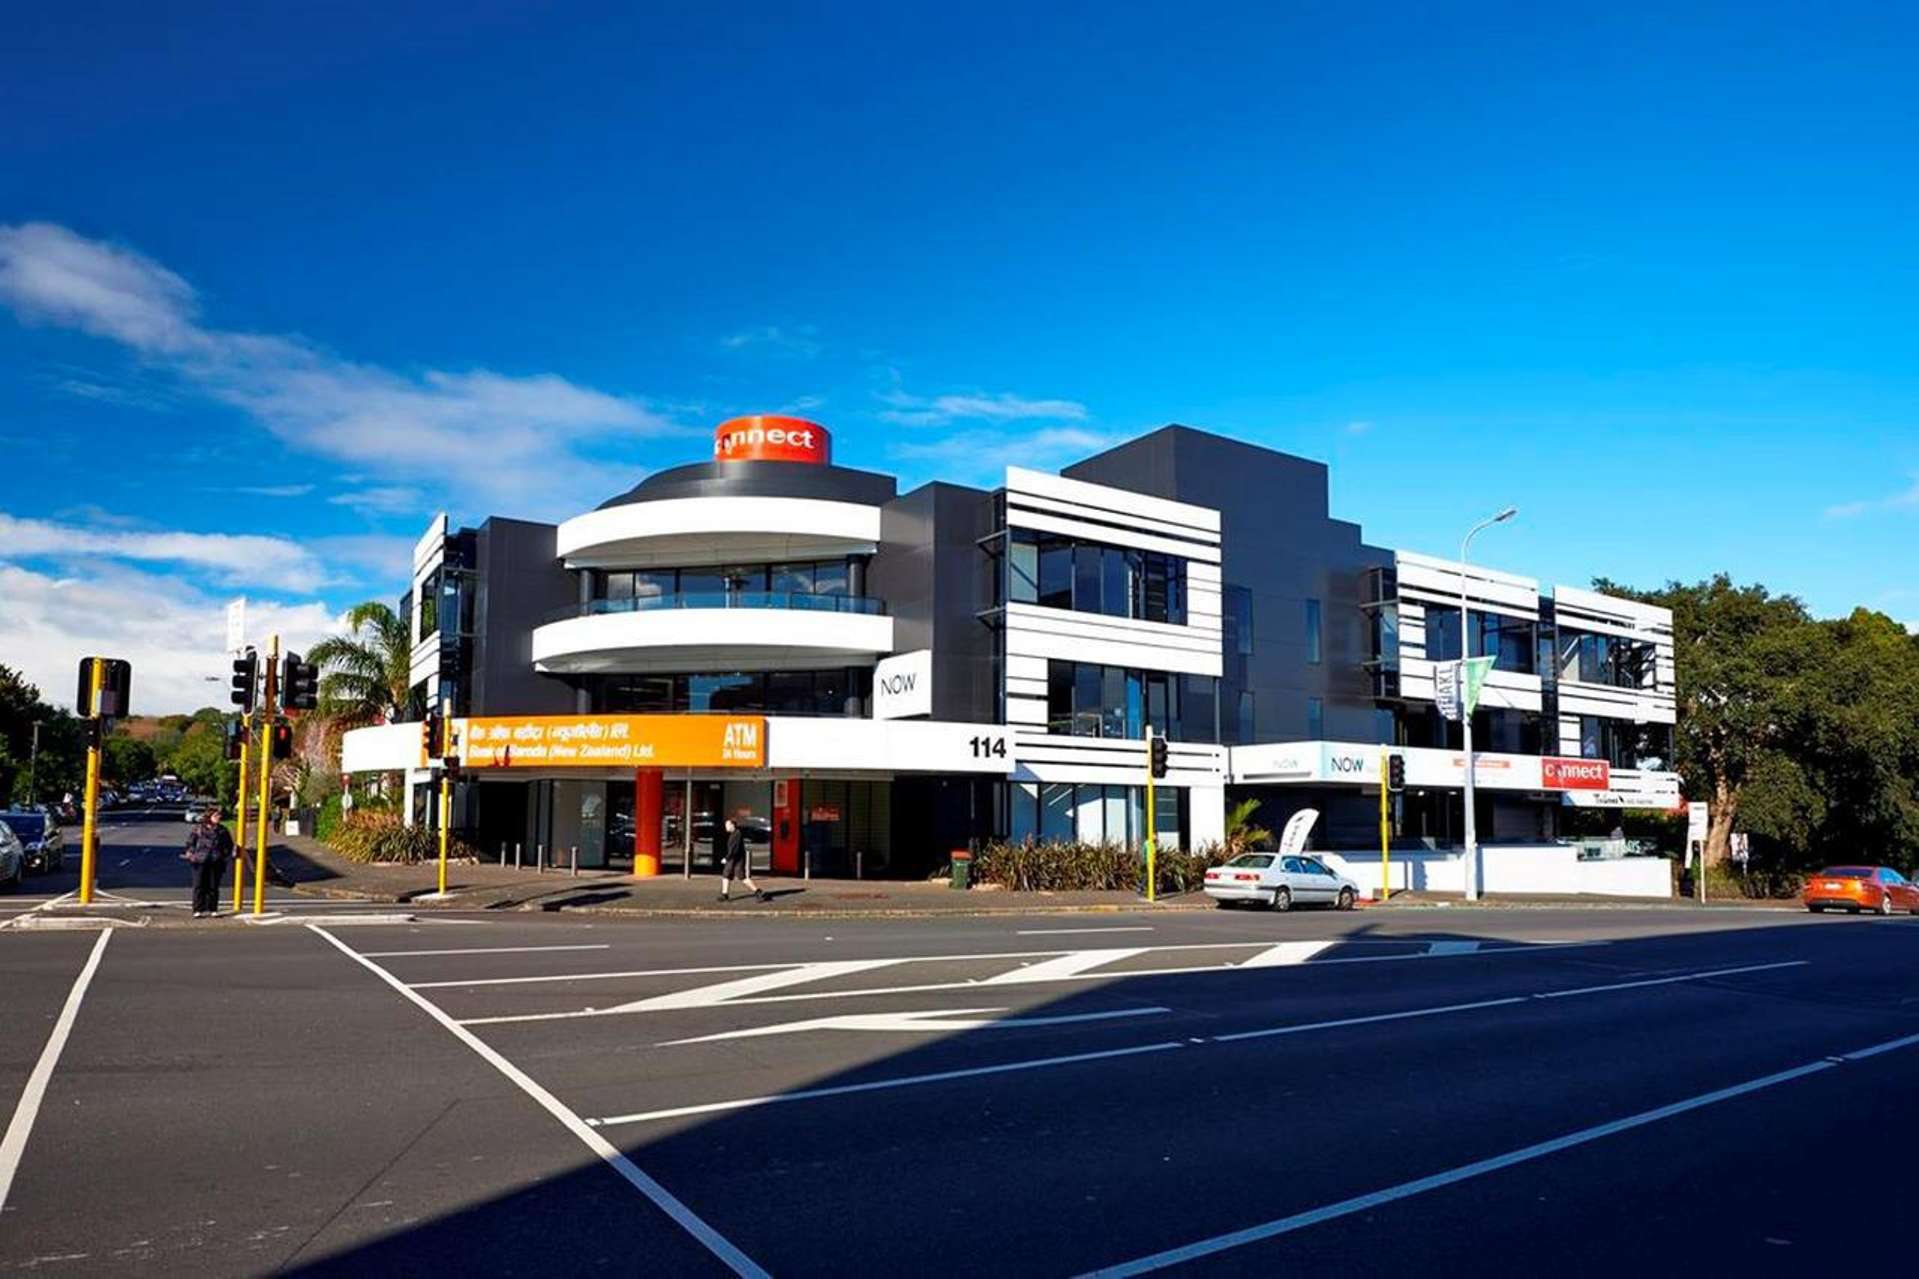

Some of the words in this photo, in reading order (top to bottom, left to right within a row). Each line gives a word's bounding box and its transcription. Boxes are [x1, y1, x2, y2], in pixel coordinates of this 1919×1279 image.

[881, 672, 916, 696] NOW
[724, 723, 757, 746] ATM
[969, 735, 1007, 759] 114
[1331, 757, 1364, 773] NOW
